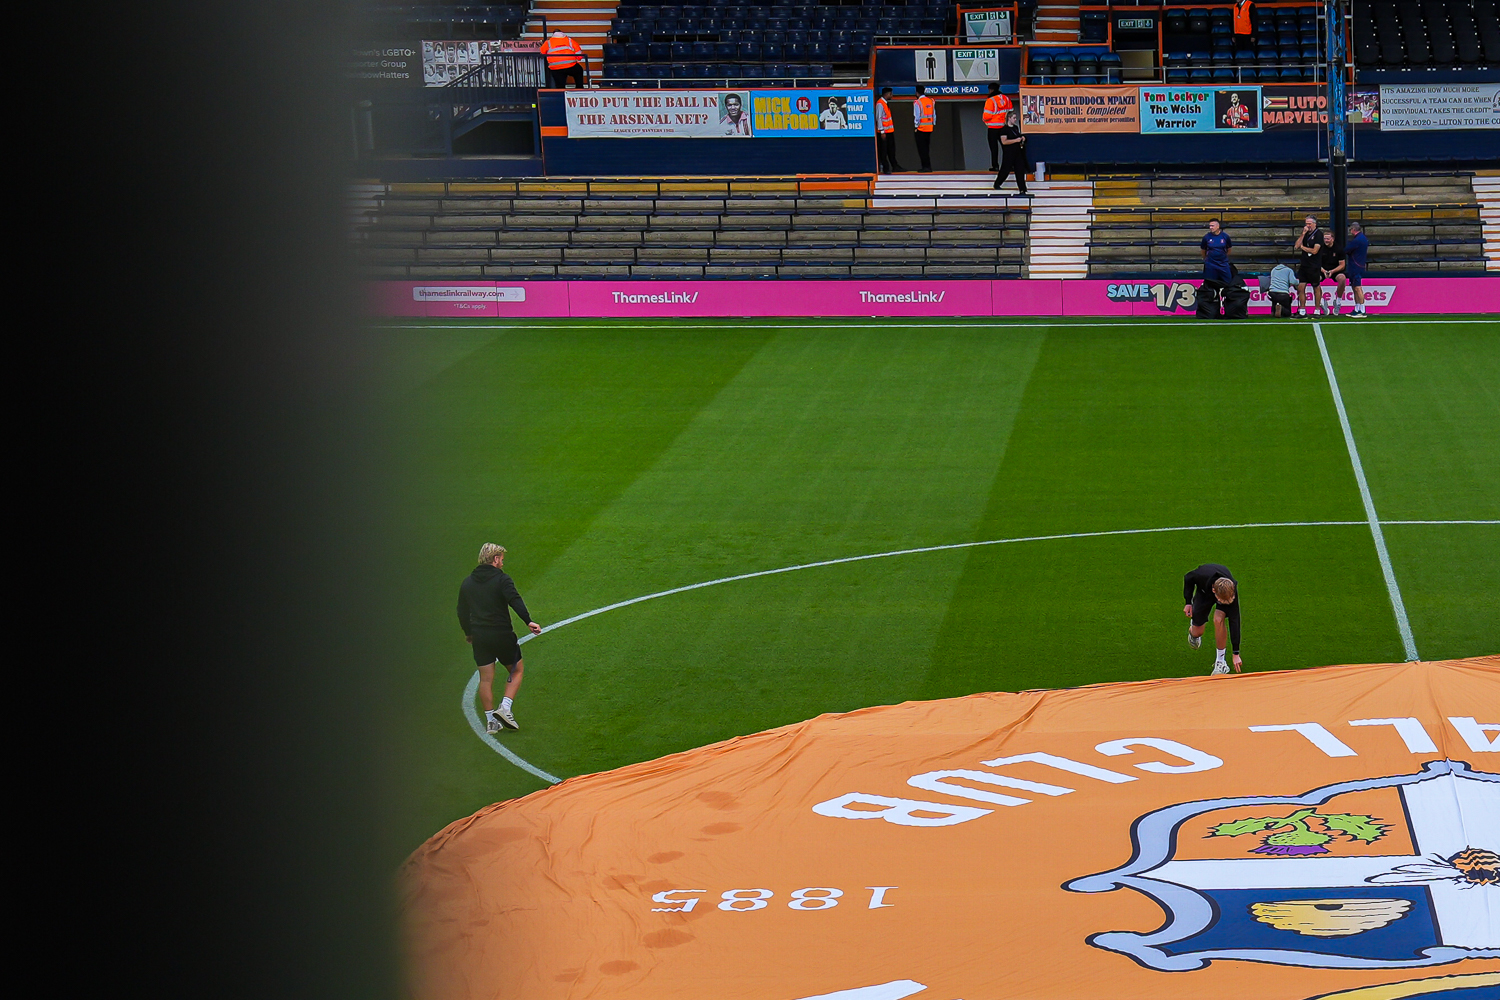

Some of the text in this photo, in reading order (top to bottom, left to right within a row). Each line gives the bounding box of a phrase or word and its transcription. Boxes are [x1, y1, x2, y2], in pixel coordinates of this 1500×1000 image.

[513, 41, 529, 49] Class
[382, 49, 416, 57] LGBTQ+
[381, 60, 407, 69] Group
[984, 62, 989, 76] 1
[566, 96, 718, 108] WHO PUT THE BALL IN
[1045, 95, 1136, 106] PELLY RUDDOCK MPANZU
[1144, 91, 1210, 103] Tom Lockyer
[1289, 96, 1328, 109] LUTO
[754, 97, 791, 113] MICK
[1150, 104, 1202, 114] The Welsh
[1050, 106, 1126, 116] Football: Completed
[577, 114, 708, 124] THE ARSENAL NET?
[754, 113, 819, 130] HARFORD
[1155, 118, 1196, 128] Warrior
[1263, 111, 1328, 124] MARVELO
[848, 122, 863, 130] DIES
[419, 290, 505, 299] thameslinkrailway.com
[1107, 284, 1150, 299] SAVE
[812, 737, 1223, 828] CLUB
[651, 886, 899, 913] 1885
